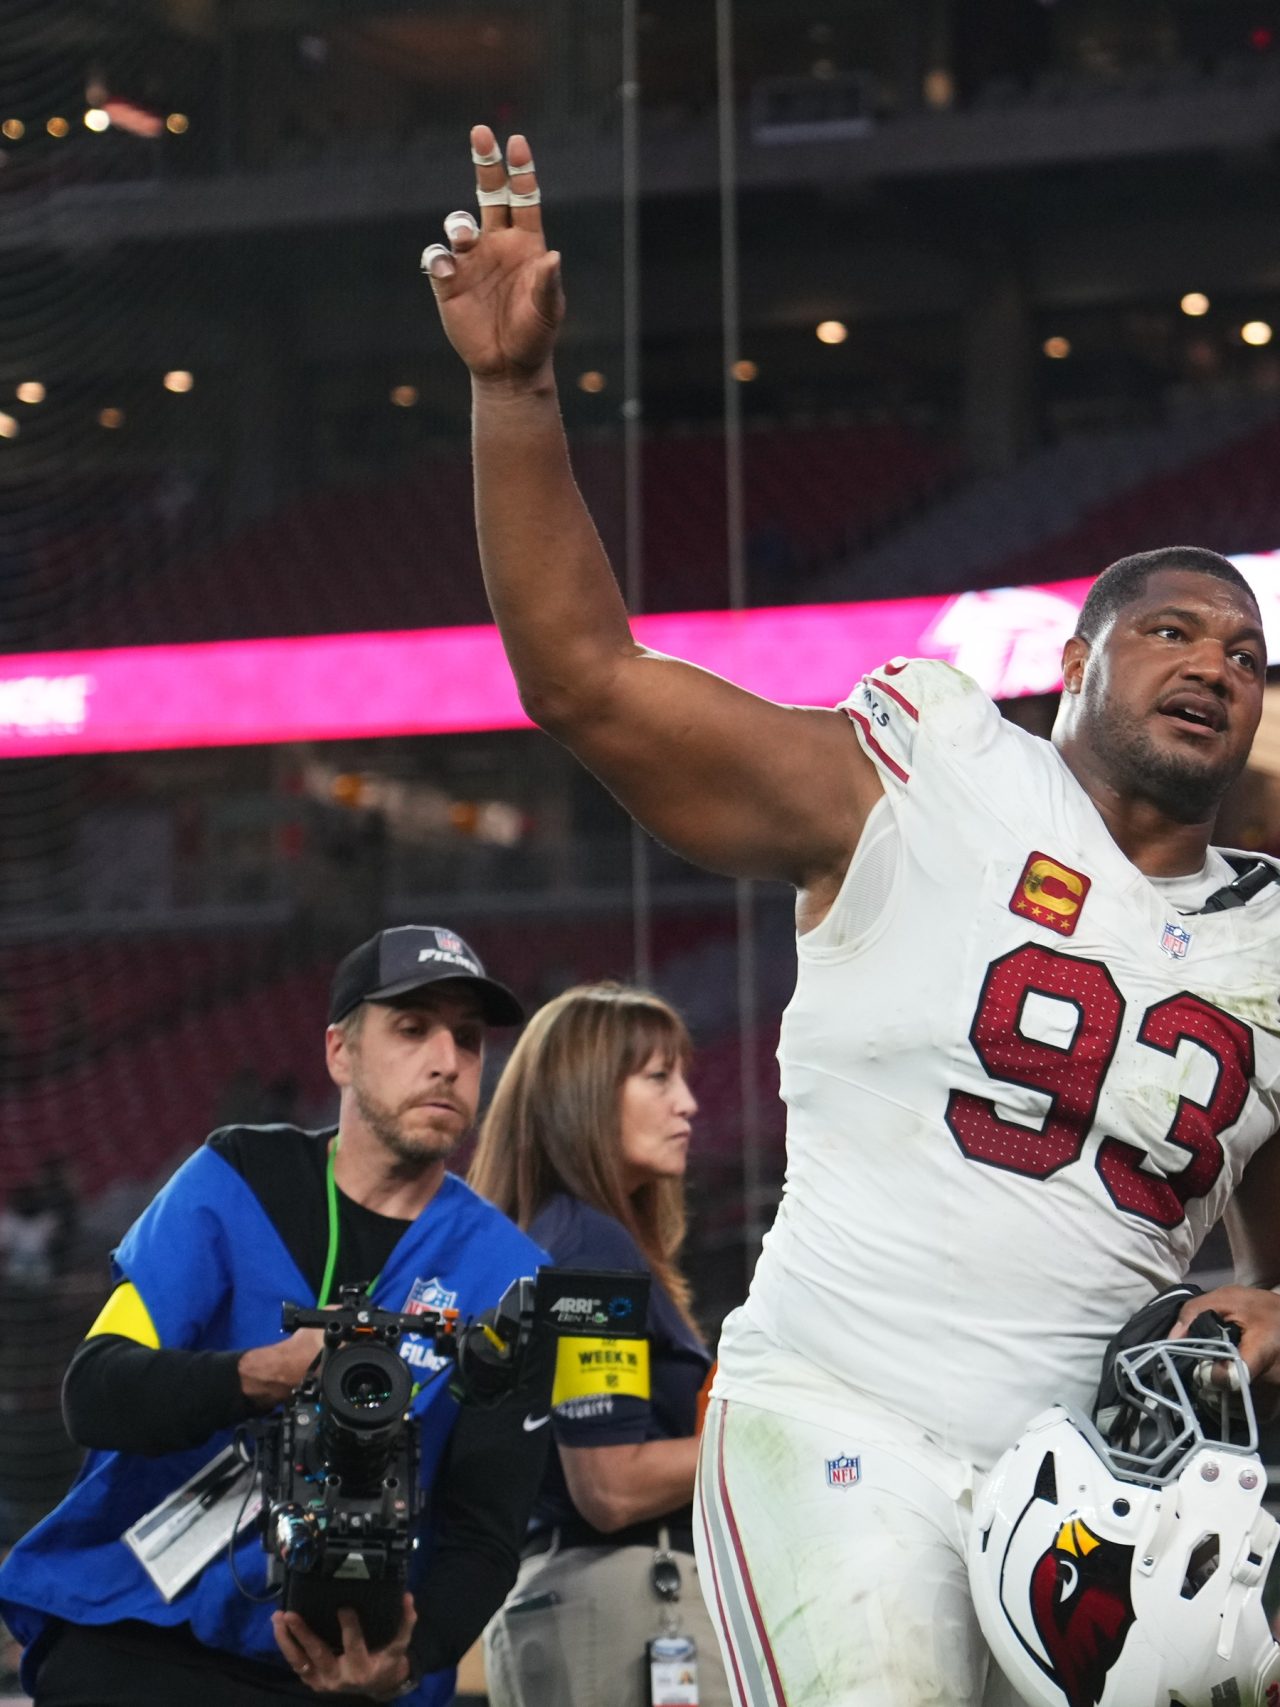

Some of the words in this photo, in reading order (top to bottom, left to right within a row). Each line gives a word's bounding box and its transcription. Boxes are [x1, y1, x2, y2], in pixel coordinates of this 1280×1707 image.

[1024, 859, 1084, 916] C
[419, 949, 479, 976] FILMS
[943, 940, 1256, 1232] 93
[549, 1297, 593, 1314] ARRI
[578, 1350, 624, 1366] WEEK
[832, 1467, 856, 1483] NFL
